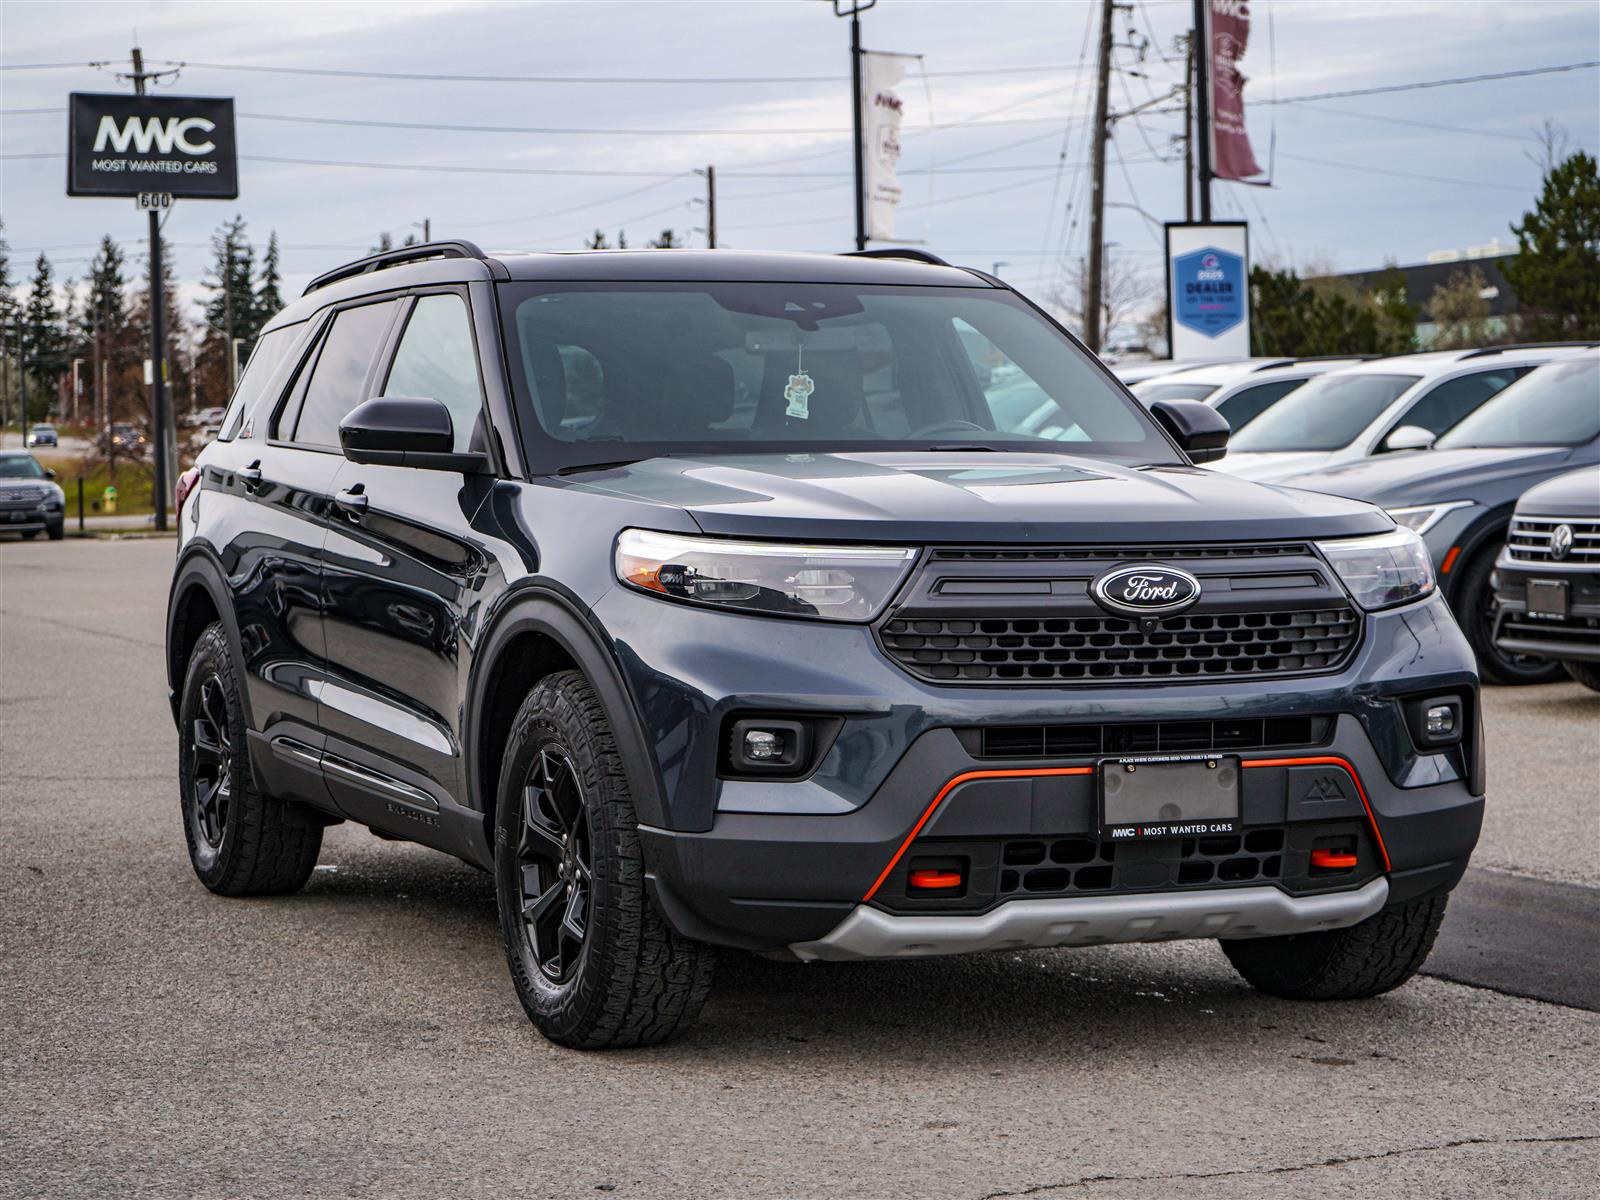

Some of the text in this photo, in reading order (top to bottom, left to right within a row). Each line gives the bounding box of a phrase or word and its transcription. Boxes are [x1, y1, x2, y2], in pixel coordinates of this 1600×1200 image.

[92, 115, 216, 155] MWC
[92, 159, 218, 174] MOST WANTED CARS
[141, 193, 171, 208] 600
[1123, 575, 1178, 601] Ford
[1112, 823, 1233, 838] MWC MOST WANTED CARS
